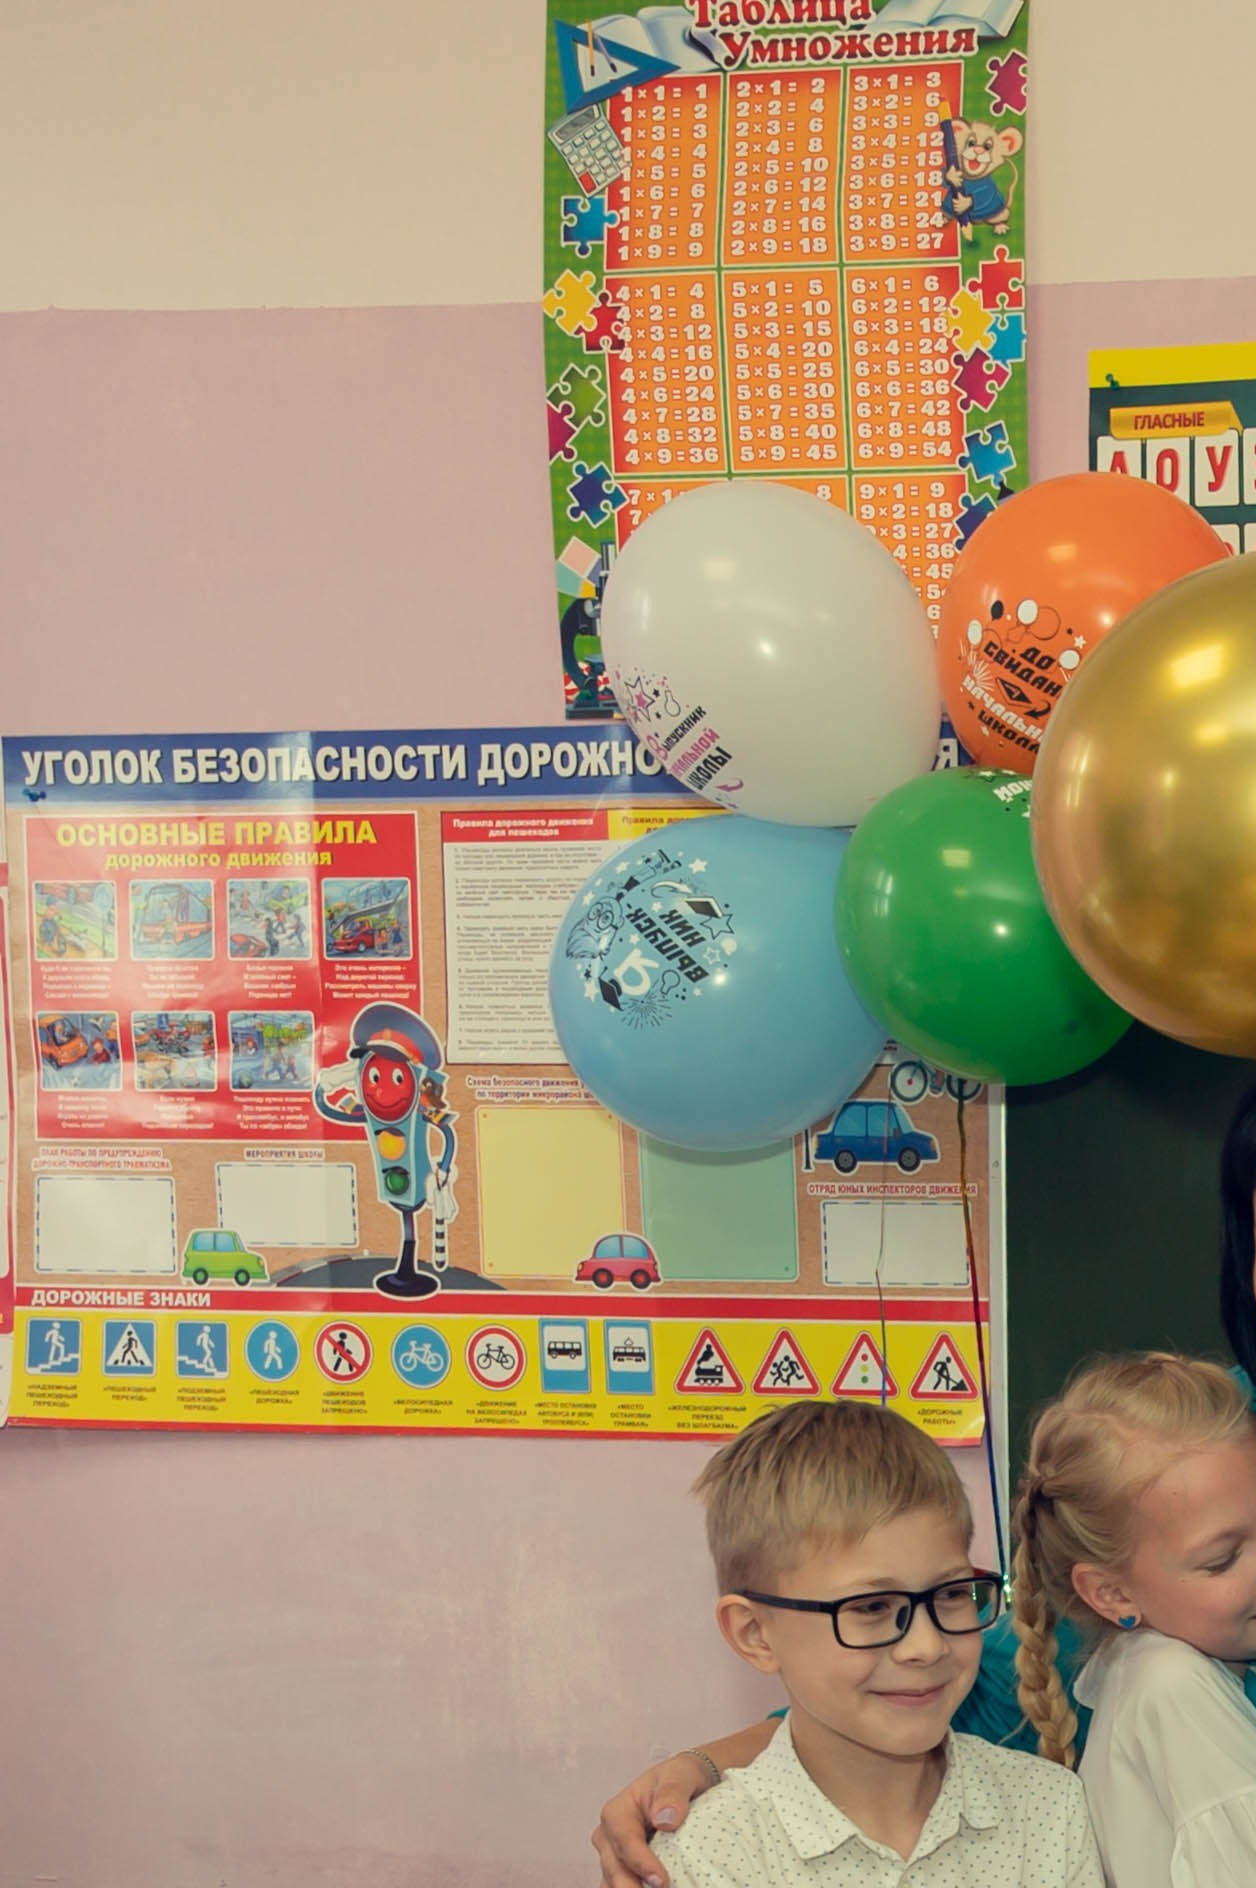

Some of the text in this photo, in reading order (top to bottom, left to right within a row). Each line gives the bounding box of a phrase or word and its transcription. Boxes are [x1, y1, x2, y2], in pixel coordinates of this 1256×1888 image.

[689, 0, 873, 27] Таблица
[719, 28, 976, 67] Умножения
[1133, 411, 1205, 430] ГЛАСНЫЕ
[1205, 445, 1233, 493] У
[983, 640, 1063, 697] СВИДАН
[1019, 647, 1057, 670] ДО
[962, 675, 1044, 740] НАЧАЛЬН
[21, 740, 663, 787] УГОЛОК БЕЗОПАСНОСТИ ДОРОЖНО
[56, 820, 377, 848] ОСНОВНЫЕ ПРАВИЛА
[105, 851, 333, 870] дорожного движения
[808, 1184, 836, 1194] ОТРЯД
[838, 1184, 864, 1194] ЮНЫХ
[31, 1289, 211, 1307] ДОРОЖНЫЕ ЗНАКИ
